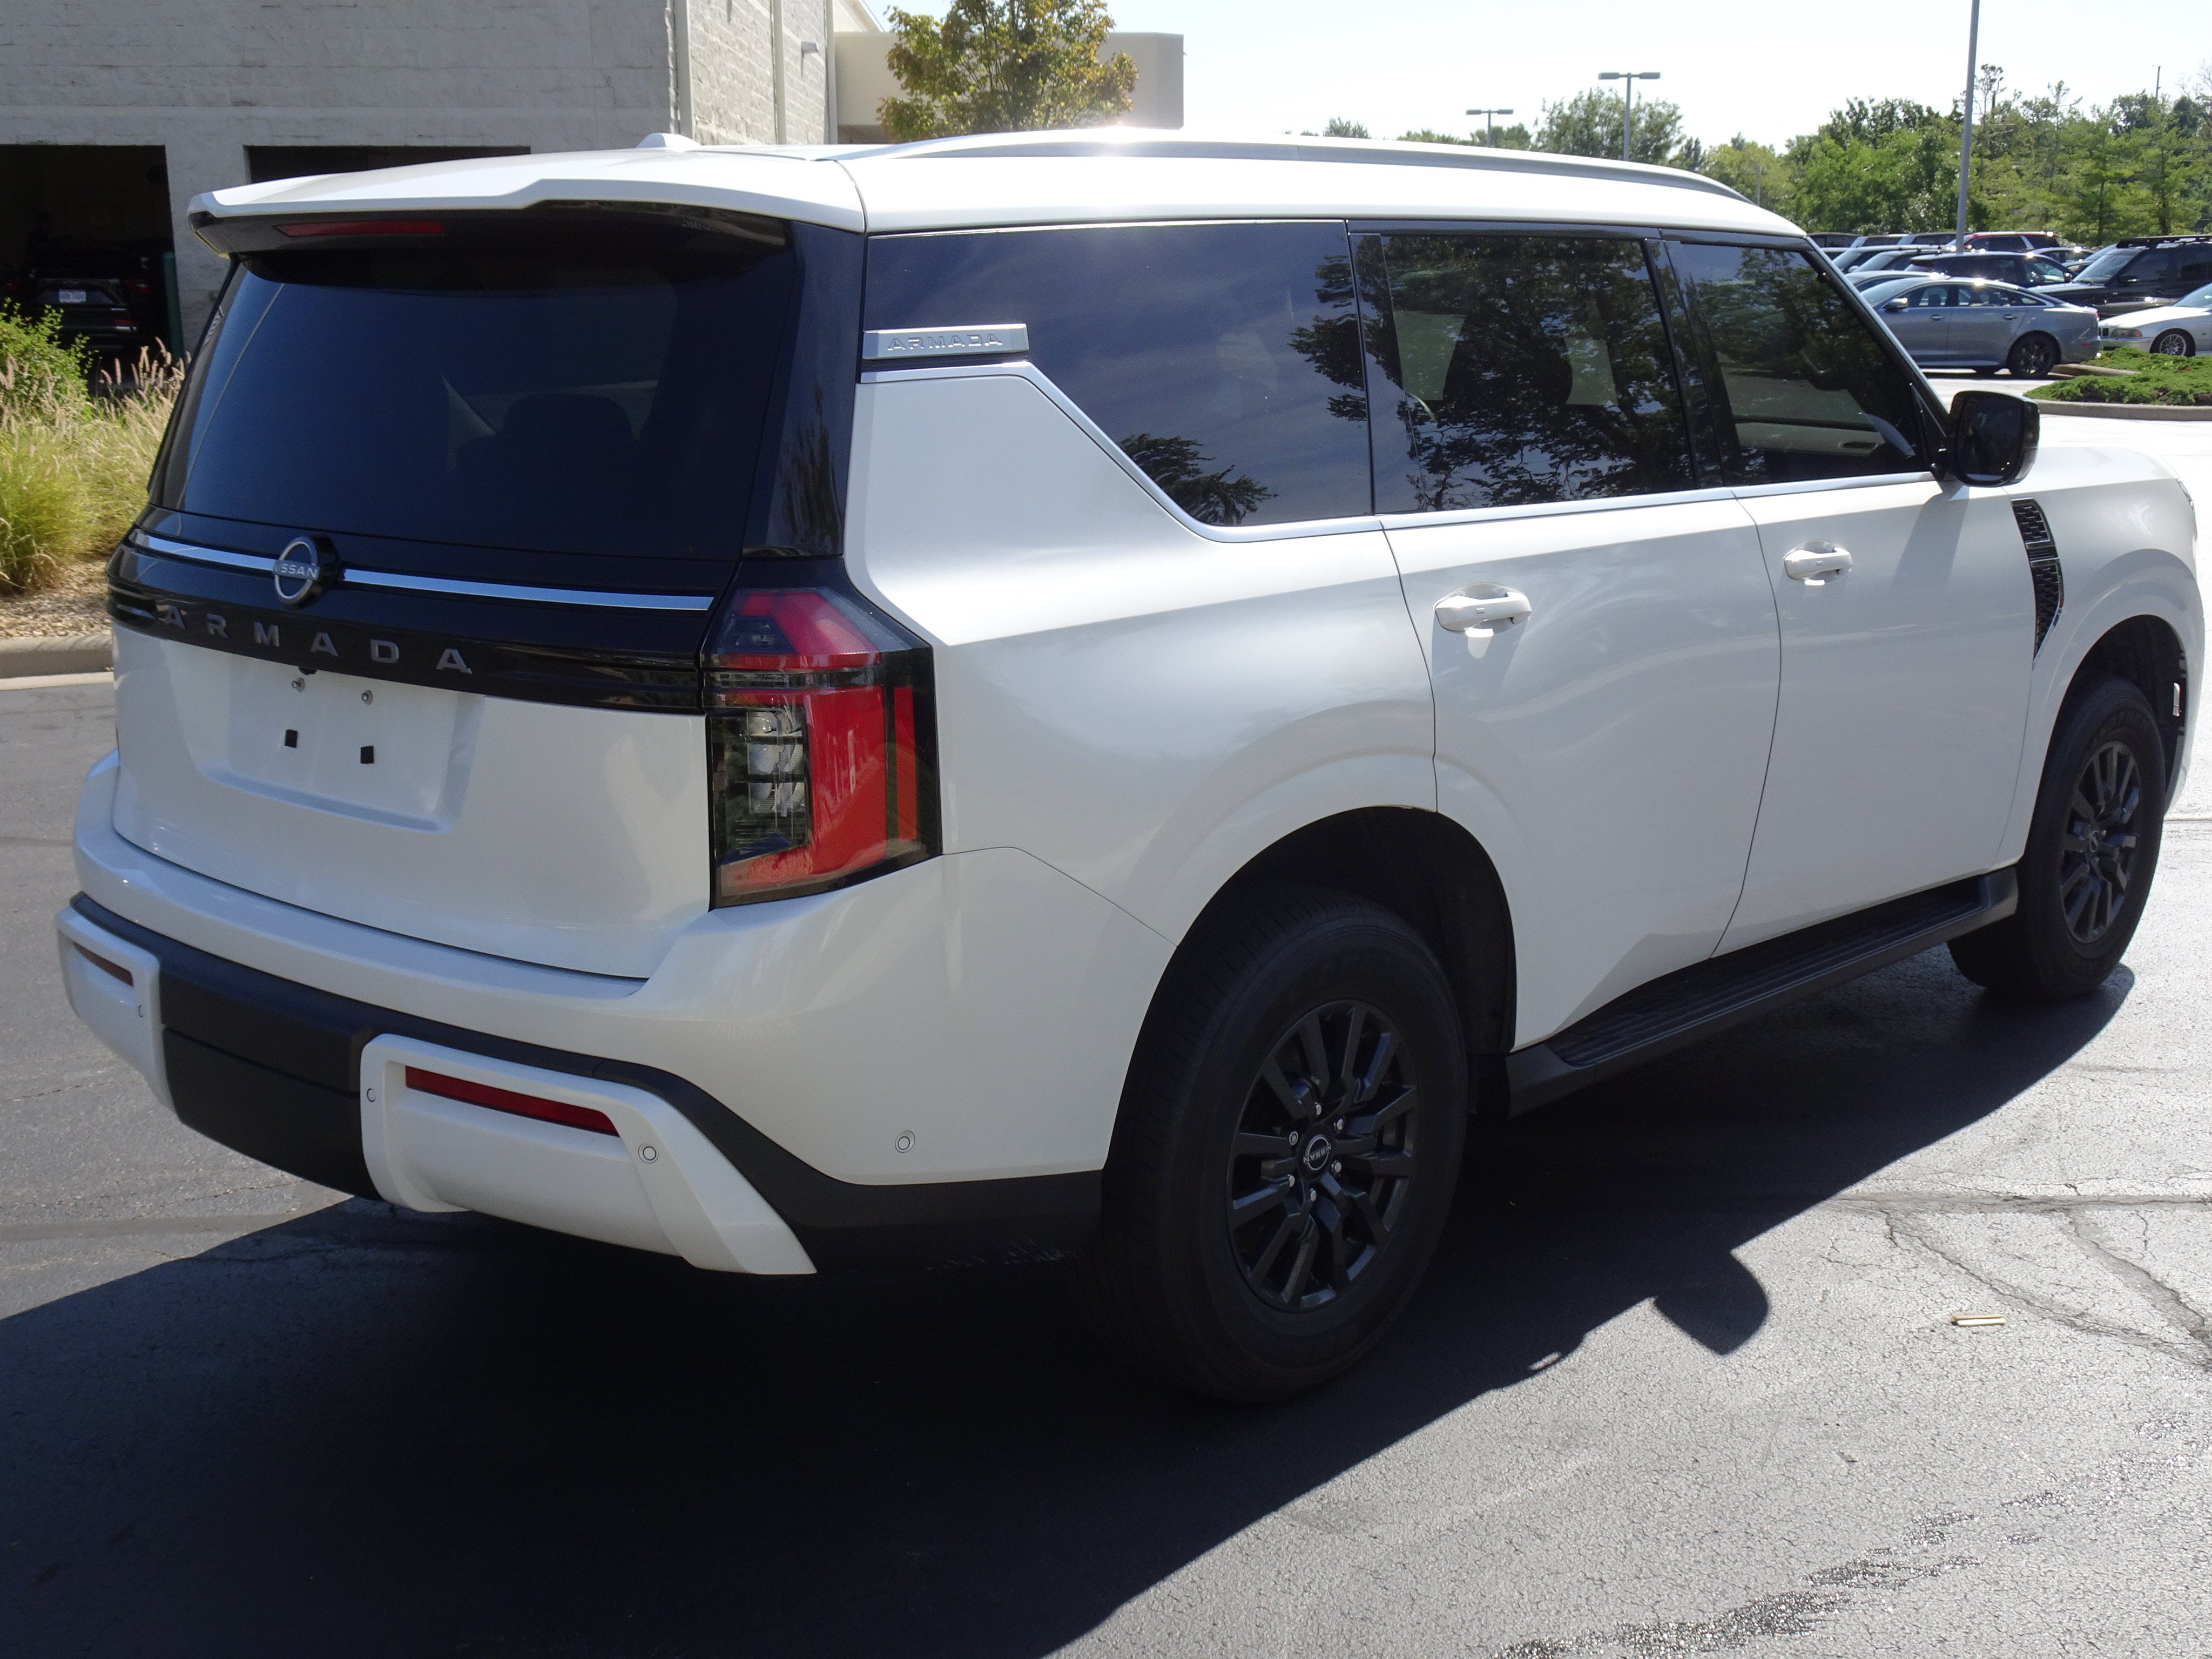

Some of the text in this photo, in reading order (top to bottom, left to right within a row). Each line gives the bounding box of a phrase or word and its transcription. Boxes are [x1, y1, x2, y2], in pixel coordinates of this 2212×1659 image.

[887, 333, 1003, 351] ARMADA
[274, 563, 319, 578] SSAN
[159, 605, 473, 675] ARMADA
[1303, 1143, 1332, 1163] NISSAN
